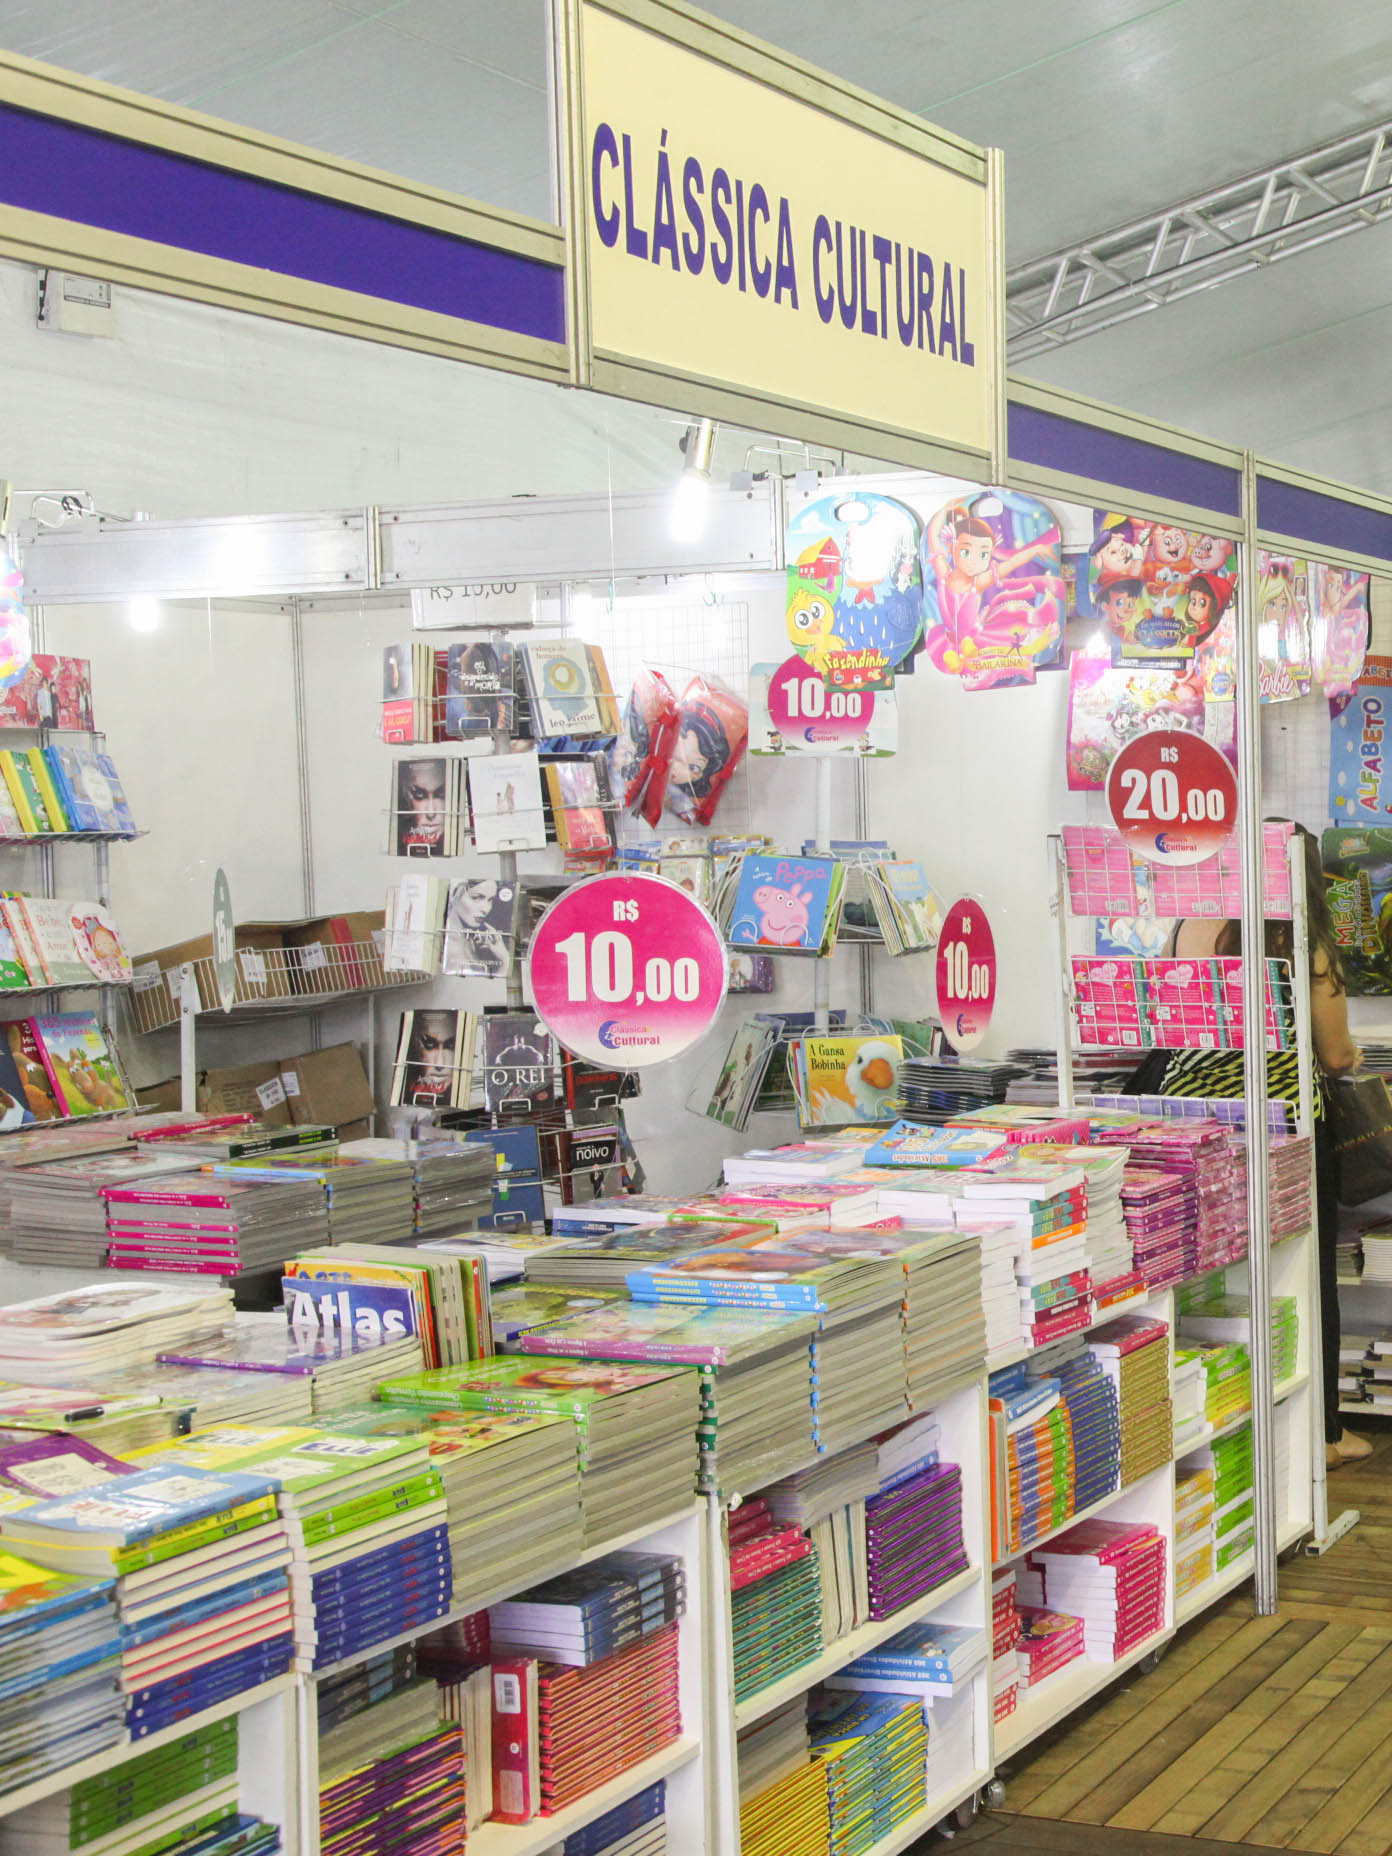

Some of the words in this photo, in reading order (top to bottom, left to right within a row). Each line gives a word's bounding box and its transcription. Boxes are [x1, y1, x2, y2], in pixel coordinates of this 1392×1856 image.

[592, 122, 799, 311] CLÁSSICA
[812, 214, 975, 368] CULTURAL
[781, 677, 862, 720] 10,00
[1160, 746, 1179, 764] R$
[1359, 696, 1385, 812] ALFABETO
[1121, 768, 1225, 824] 20,00
[775, 861, 827, 885] Peppa
[612, 899, 640, 922] R$
[1327, 880, 1355, 946] MEGA
[962, 917, 972, 934] R$
[555, 931, 700, 1006] 10,00
[943, 941, 990, 1003] 10,00
[614, 1034, 660, 1046] Cultural
[818, 1044, 845, 1056] Gansa
[515, 1068, 546, 1085] REI
[811, 1058, 846, 1071] Bobinha
[576, 1145, 609, 1161] noivo
[292, 1289, 407, 1334] Atlas
